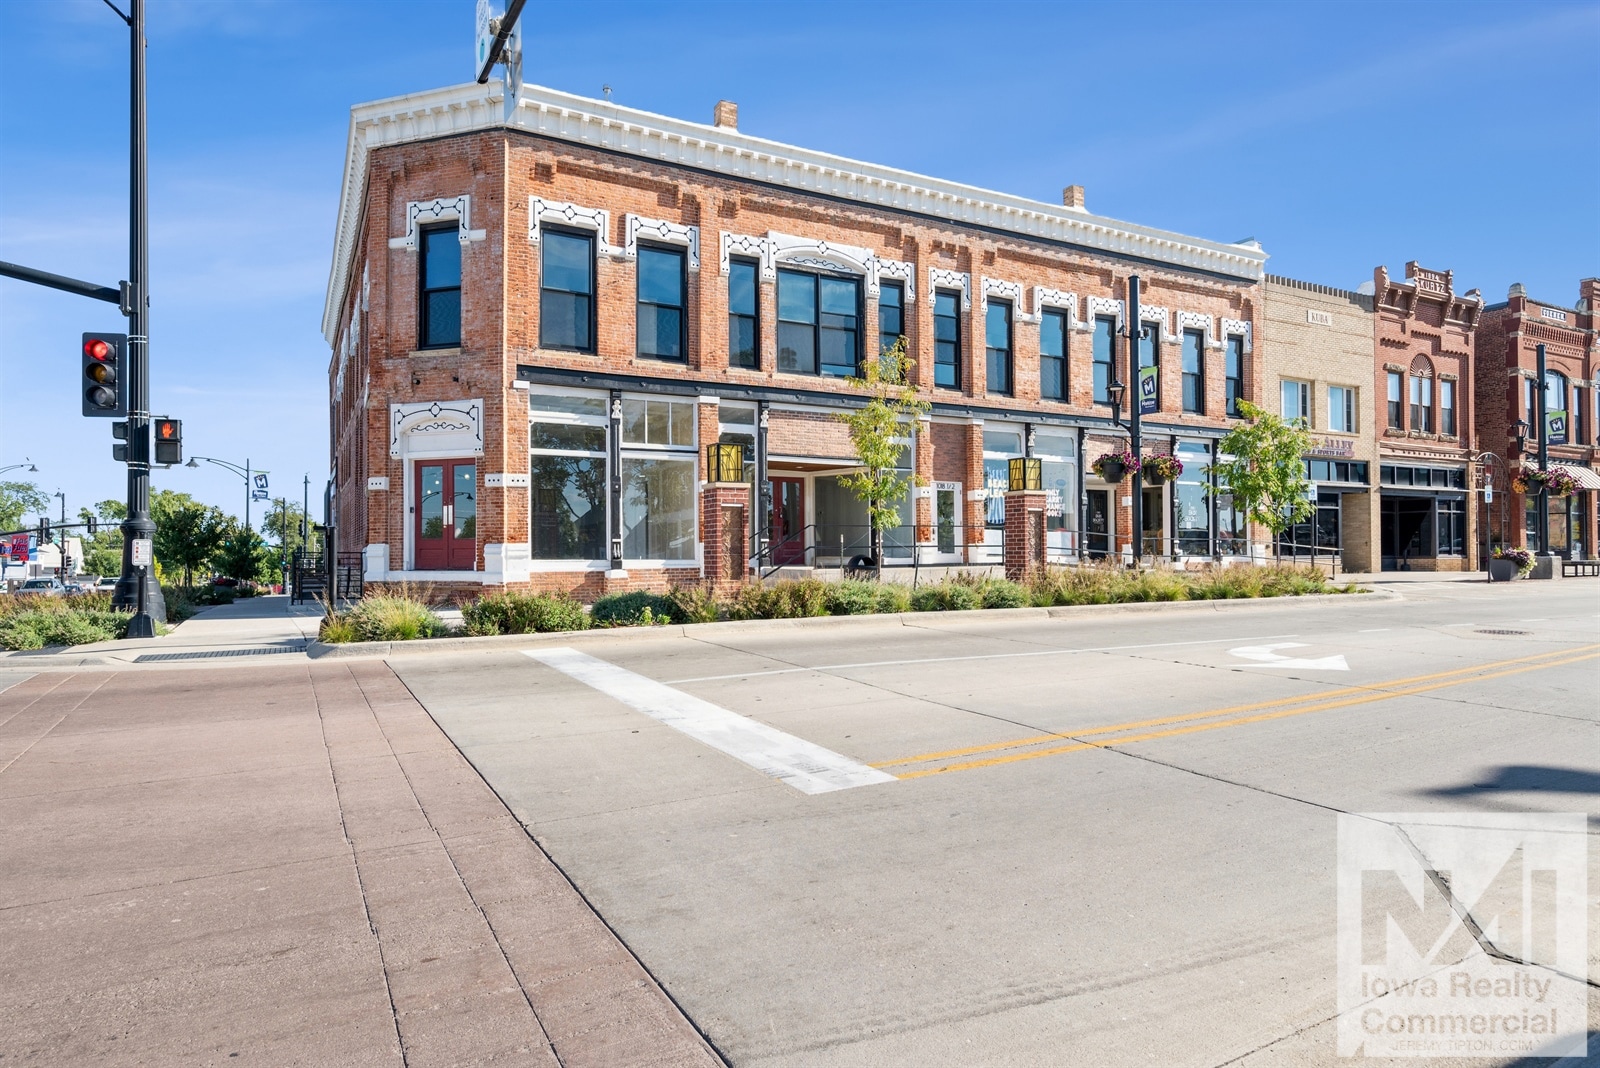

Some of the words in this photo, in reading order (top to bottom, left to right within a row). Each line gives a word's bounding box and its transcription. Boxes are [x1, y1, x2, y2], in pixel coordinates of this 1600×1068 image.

[1420, 280, 1445, 293] KURTZ
[1311, 312, 1328, 324] KUBA
[1144, 380, 1154, 395] M
[988, 479, 1009, 489] BEAC
